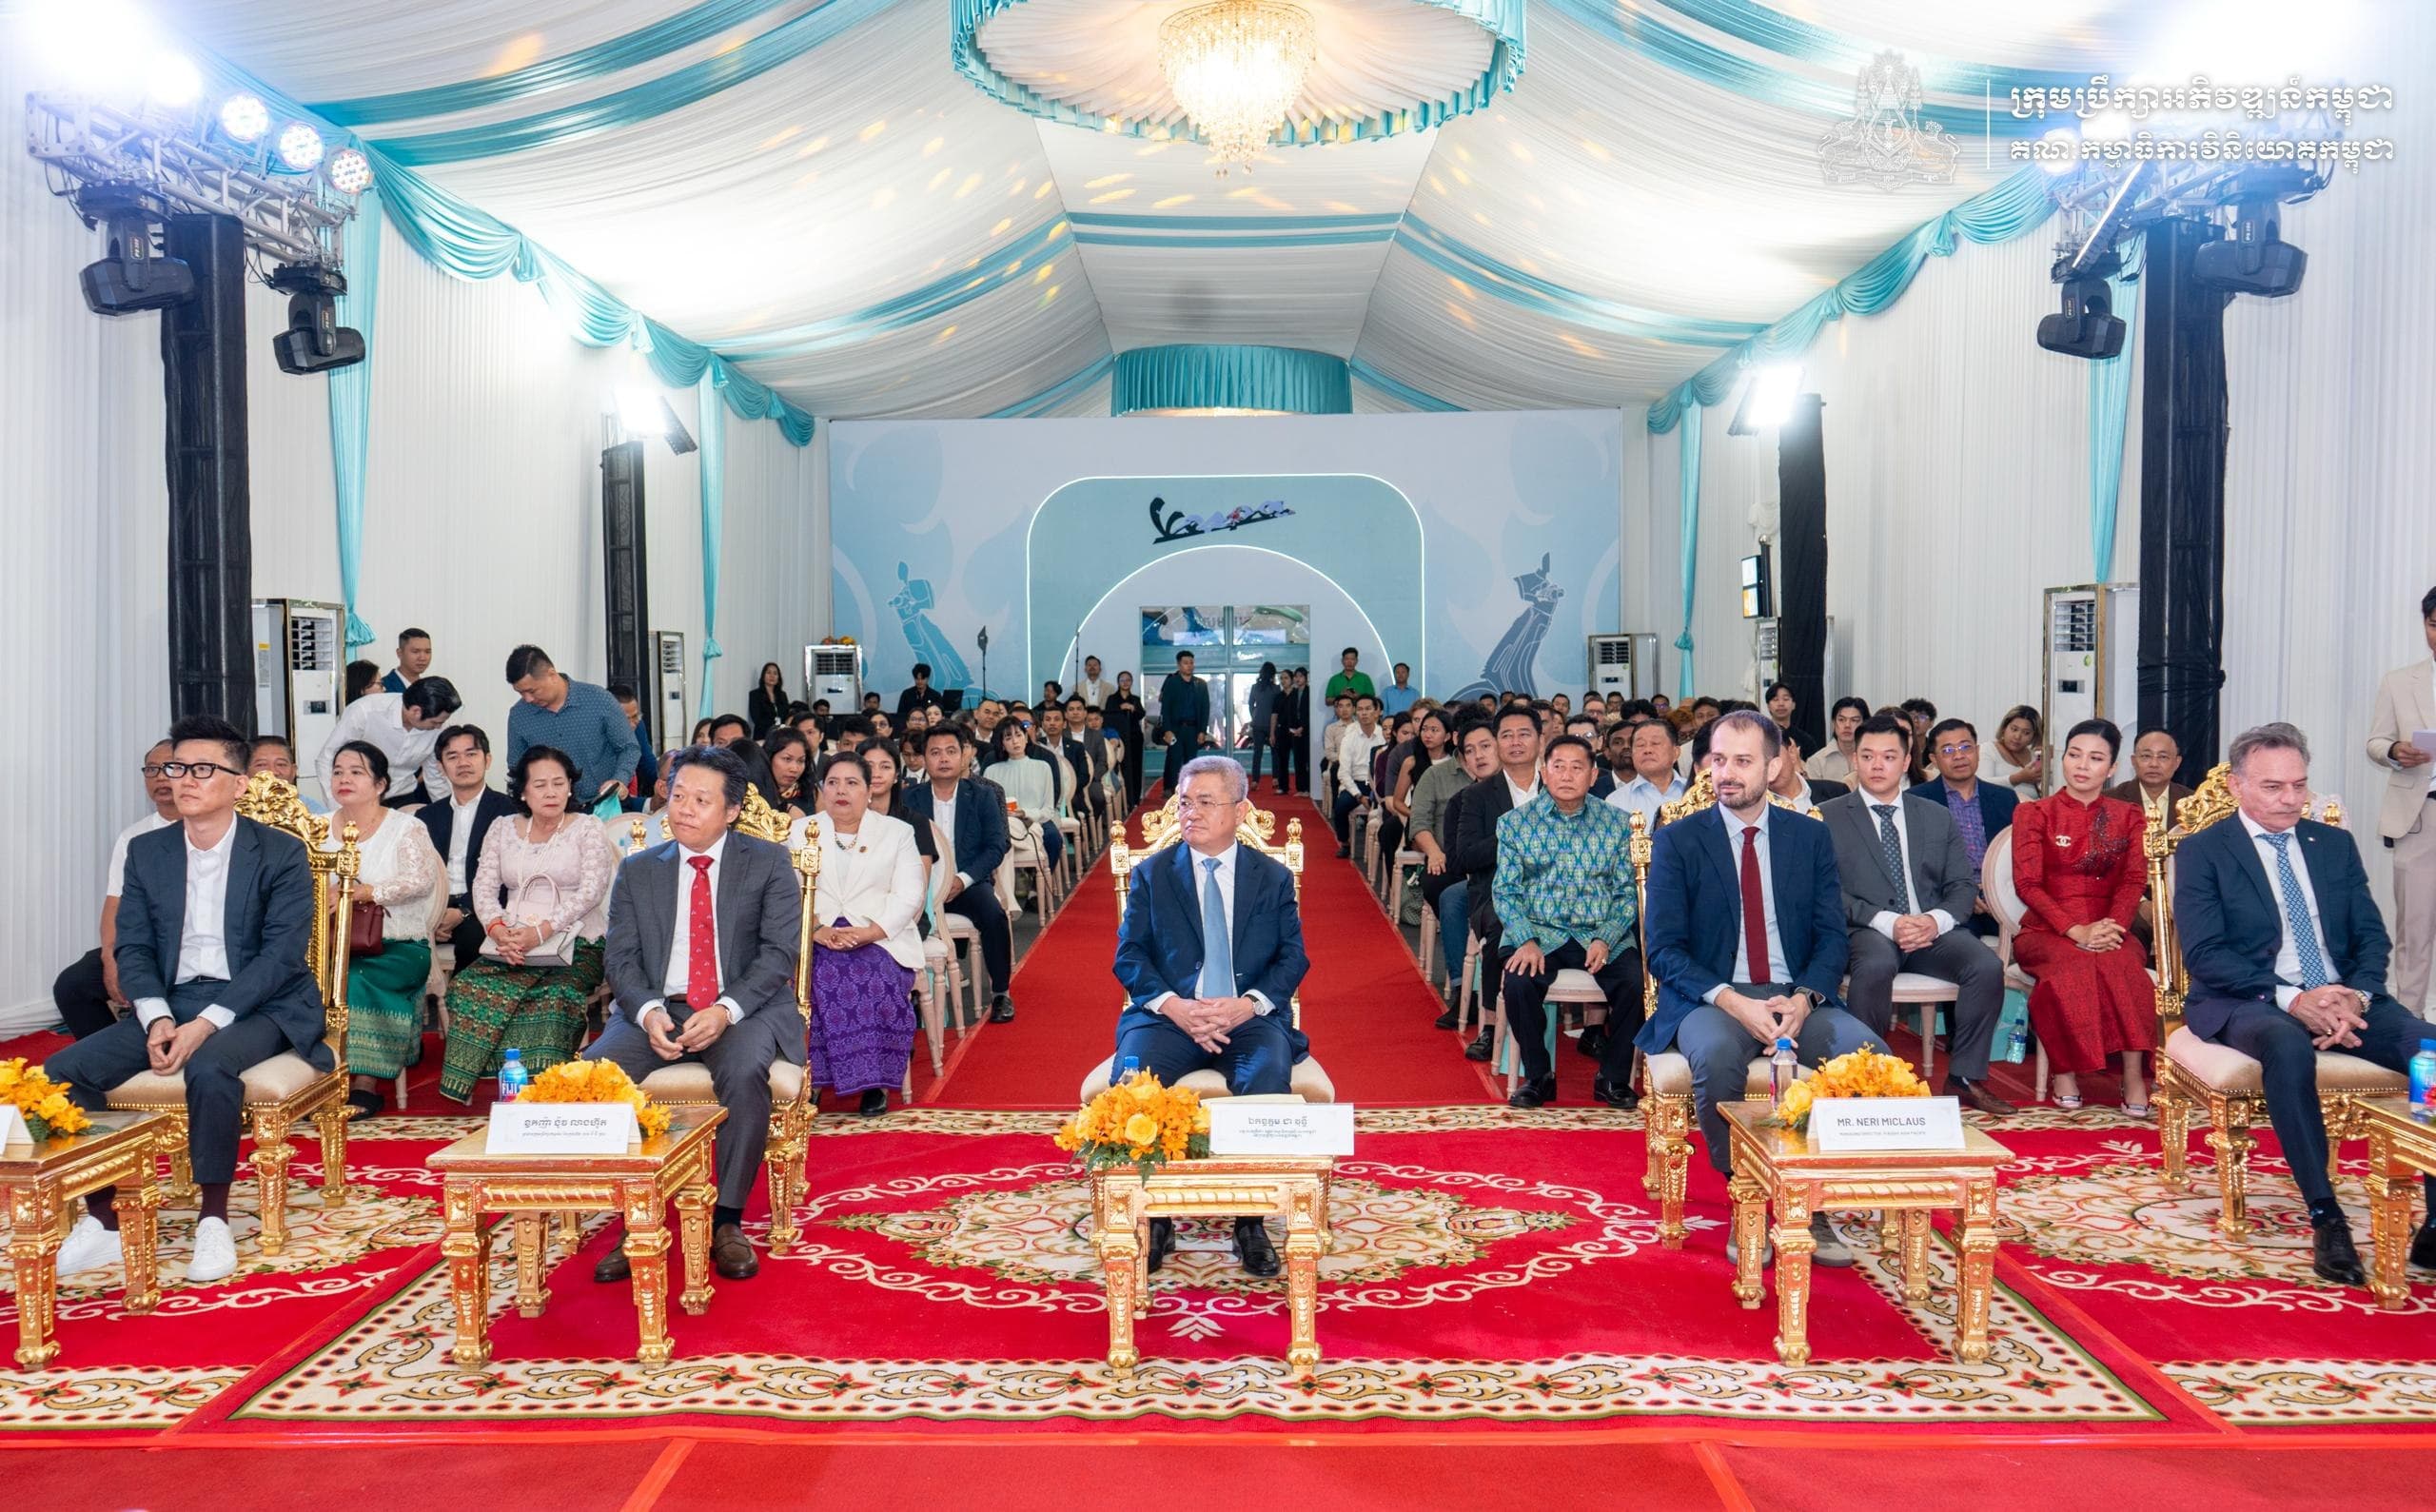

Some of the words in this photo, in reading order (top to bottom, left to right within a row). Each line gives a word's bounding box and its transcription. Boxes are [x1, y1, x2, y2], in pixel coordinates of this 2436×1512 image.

[501, 1082, 518, 1095] FIJI
[1837, 1118, 1855, 1127] MR.
[1856, 1117, 1879, 1127] NERI
[1881, 1117, 1926, 1127] MICLAUS
